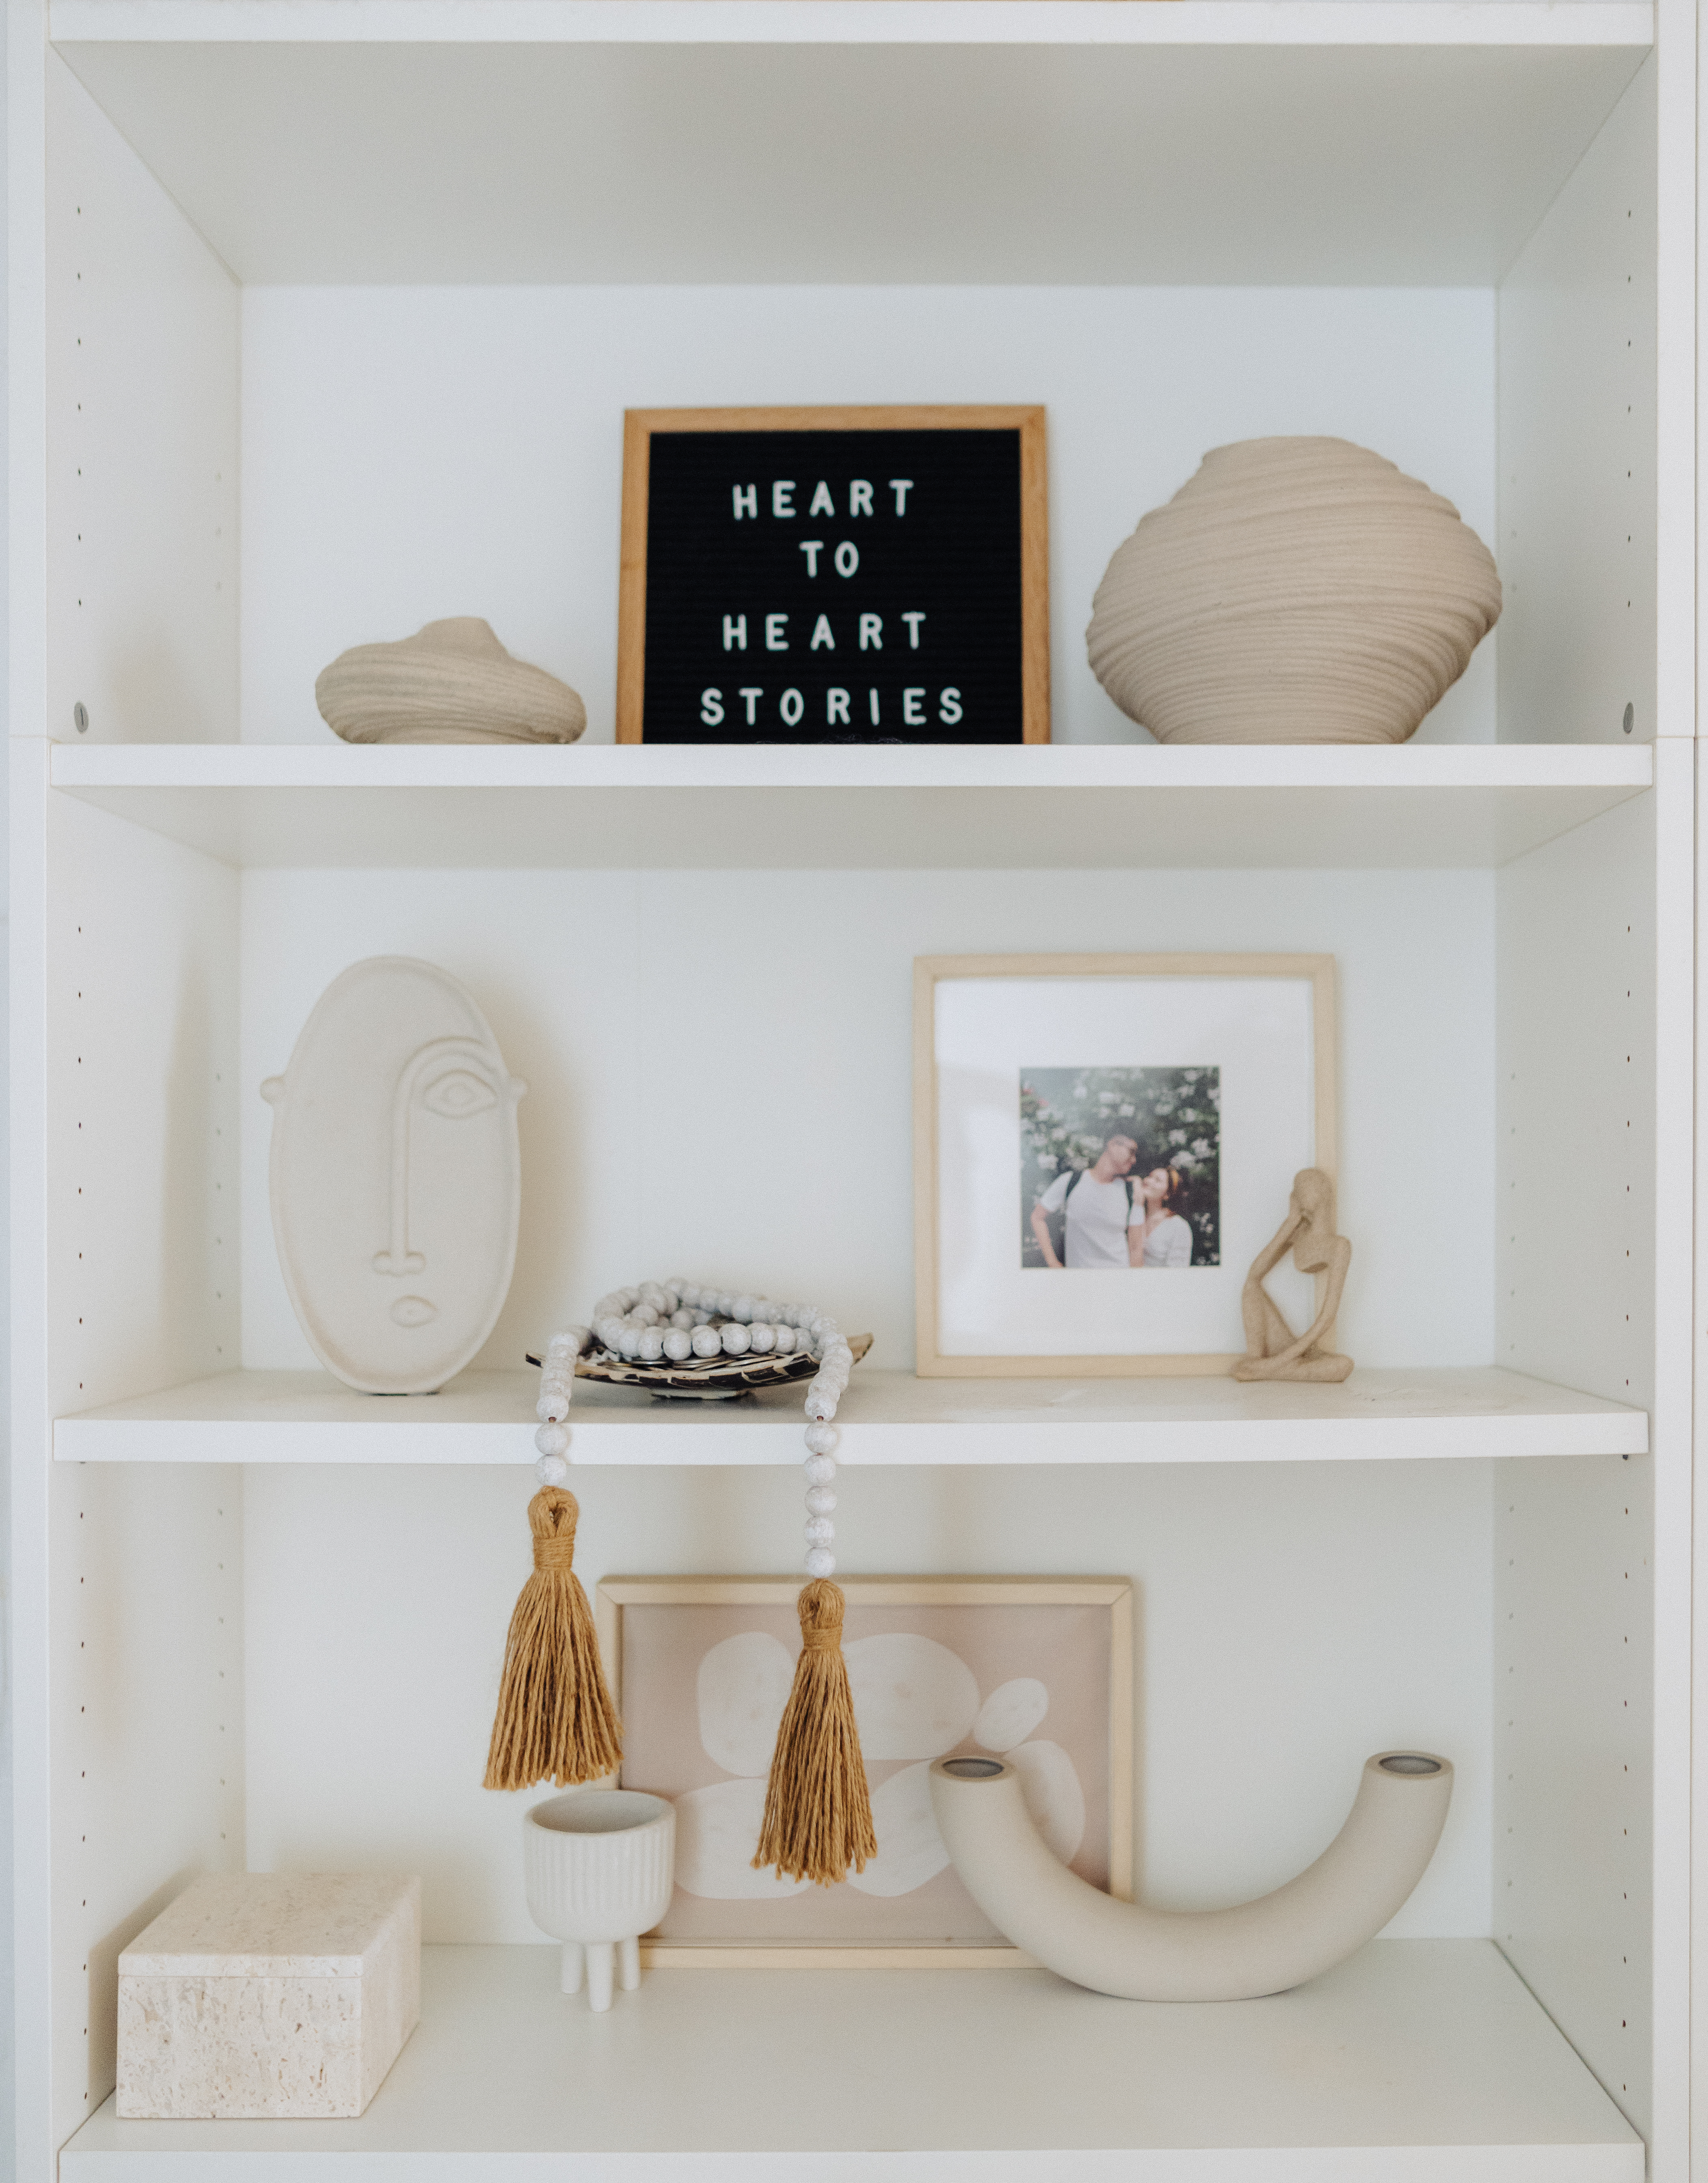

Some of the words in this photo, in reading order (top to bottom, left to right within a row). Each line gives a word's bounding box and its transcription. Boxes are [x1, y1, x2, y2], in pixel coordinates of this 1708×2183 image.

[732, 479, 914, 520] HEART
[799, 540, 860, 578] TO
[722, 611, 926, 651] HEART
[700, 687, 963, 726] STORIES
